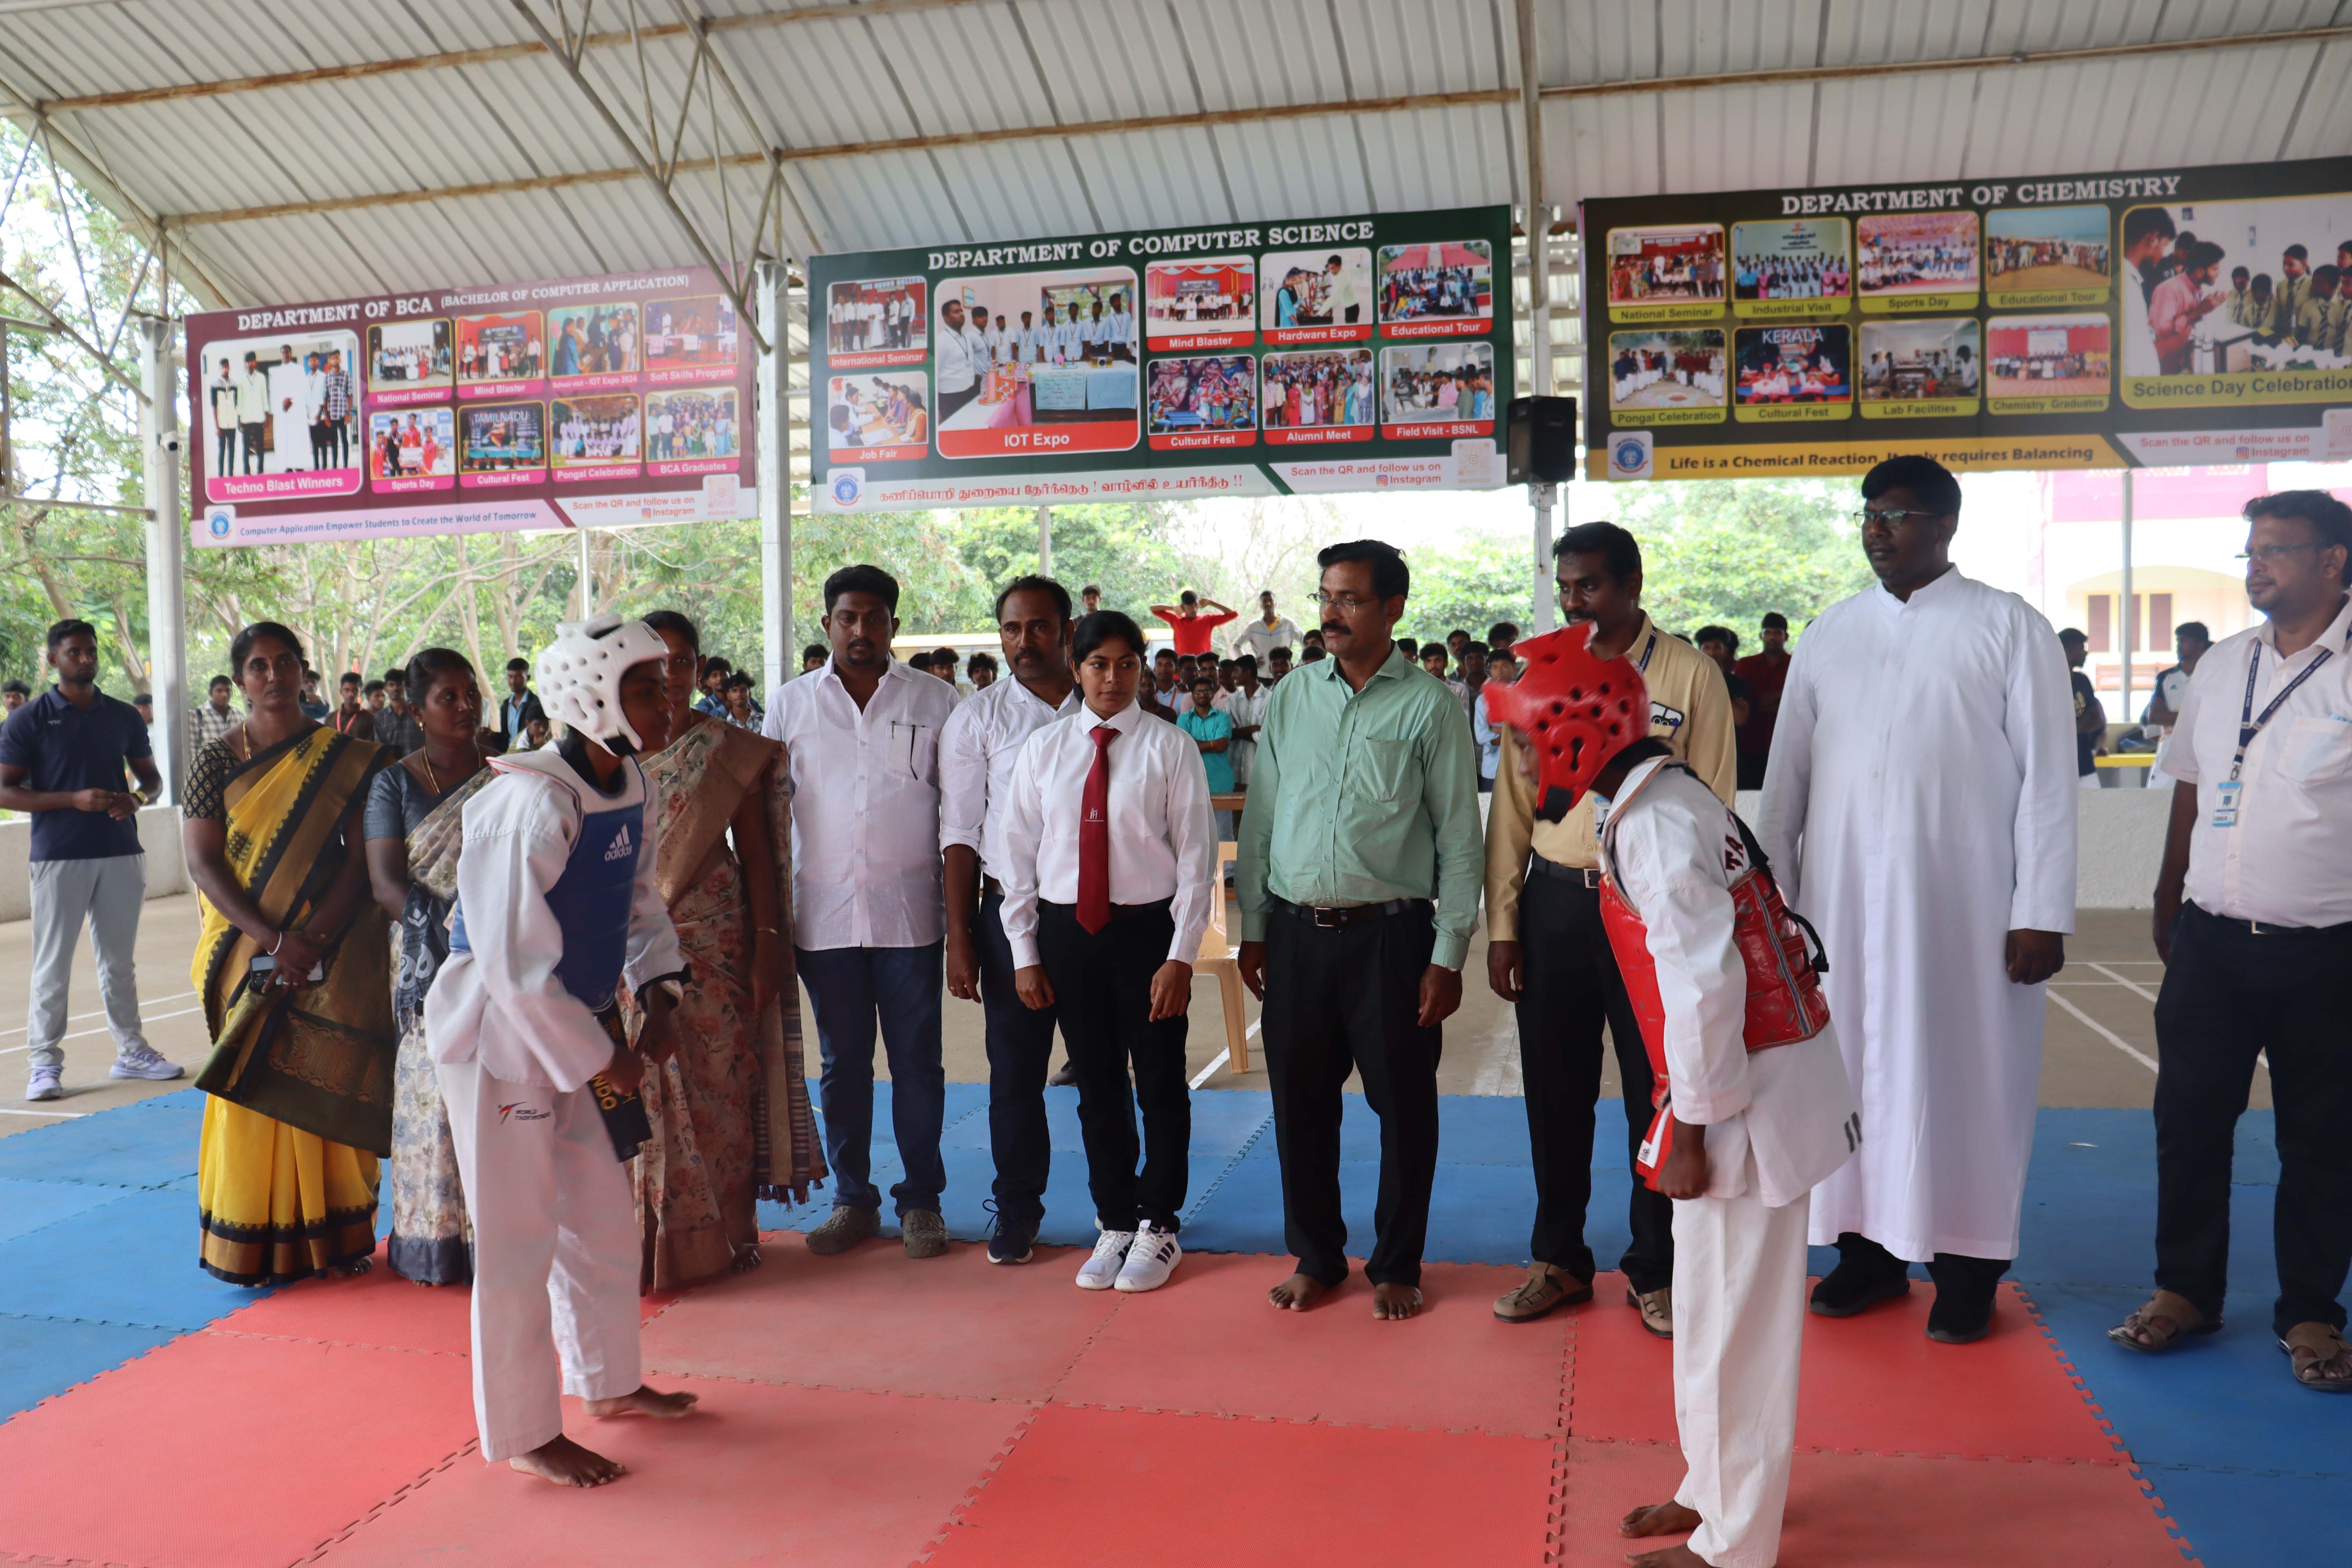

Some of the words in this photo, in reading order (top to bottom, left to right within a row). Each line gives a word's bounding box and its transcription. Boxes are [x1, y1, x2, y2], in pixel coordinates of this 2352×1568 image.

[1782, 186, 1964, 215] DEPARTMENT
[1972, 185, 2009, 205] OF
[2016, 176, 2181, 203] CHEMISTRY
[927, 242, 1083, 270] DEPARTMENT
[1090, 240, 1121, 258] OF
[1129, 229, 1261, 255] COMPUTER
[1269, 221, 1374, 245] SCIENCE
[238, 303, 360, 331] DEPARTMENT
[365, 301, 390, 318] OF
[395, 297, 433, 315] BCA
[441, 292, 508, 308] (BACHELOR
[512, 290, 528, 301] OF
[532, 283, 599, 299] COMPUTER
[603, 275, 689, 292] APPLICATION)
[1889, 298, 1925, 309] Sports
[1928, 296, 1949, 308] Day
[2000, 294, 2067, 305] Educational
[2071, 292, 2096, 302] Tour
[1621, 309, 1665, 319] National
[1669, 307, 1713, 318] Seminar
[1752, 303, 1804, 314] Industrial
[1808, 302, 1831, 313] Visit
[1278, 329, 1327, 341] Hardware
[1330, 328, 1356, 340] Expo
[1391, 324, 1453, 336] Educational
[1456, 323, 1480, 332] Tour
[1169, 338, 1194, 348] Mind
[1197, 336, 1232, 347] Blaster
[1762, 328, 1824, 344] KERALA
[831, 354, 885, 367] International
[887, 353, 923, 363] Seminar
[589, 377, 600, 386] IOT
[603, 377, 619, 386] Expo
[621, 375, 637, 384] 2024
[650, 372, 668, 381] Soft
[670, 371, 693, 380] Skills
[695, 369, 733, 381] Program
[474, 386, 494, 395] Mind
[496, 384, 526, 393] Blaster
[2134, 382, 2205, 397] Science
[2212, 380, 2246, 397] Day
[377, 392, 409, 403] National
[411, 390, 444, 401] Seminar
[1884, 405, 1904, 415] Lab
[1907, 403, 1957, 415] Facilities
[1994, 400, 2045, 412] Chemistry
[2051, 398, 2104, 409] Graduates
[474, 411, 528, 423] TAMILNADU
[1617, 413, 1655, 425] Pongal
[1658, 410, 1720, 422] Celebration
[1759, 408, 1802, 419] Cultural
[1805, 407, 1829, 417] Fest
[1287, 431, 1323, 442] Alumni
[1326, 430, 1351, 440] Meet
[1396, 426, 1419, 437] Field
[1423, 425, 1443, 436] Visit
[1452, 425, 1478, 434] BSNL
[1004, 434, 1029, 448] IOT
[1033, 433, 1070, 448] Expo
[1171, 436, 1210, 446] Cultural
[1213, 435, 1236, 445] Fest
[2141, 437, 2169, 447] Scan
[2172, 436, 2189, 446] the
[2193, 436, 2210, 446] QR
[2215, 435, 2235, 445] and
[2239, 434, 2274, 444] follow
[859, 450, 877, 460] Job
[880, 448, 897, 459] Fair
[1670, 458, 1699, 469] Life
[1703, 457, 1714, 468] is
[1731, 455, 1804, 467] Chemical
[1942, 450, 2008, 464] requires
[2013, 447, 2093, 461] Balancing
[2252, 447, 2309, 458] Instagram
[557, 470, 586, 481] Pongal
[588, 467, 637, 477] Celebration
[660, 465, 680, 474] BCA
[682, 462, 727, 472] Graduates
[1291, 466, 1316, 475] Scan
[1319, 466, 1335, 474] the
[1338, 465, 1353, 475] QR
[1356, 464, 1375, 473] and
[1379, 463, 1410, 472] follow
[224, 482, 263, 495] Techno
[266, 479, 294, 492] Blast
[297, 476, 343, 489] Winners
[392, 481, 417, 491] Sports
[419, 479, 435, 490] Day
[477, 475, 510, 485] Cultural
[511, 474, 530, 483] Fest
[1390, 474, 1441, 486] Instagram
[879, 488, 955, 502] கணிப்பொறி
[958, 487, 1020, 501] துறையை
[1024, 483, 1089, 496] தேர்ந்தெடு
[1101, 478, 1158, 493] வாழ்வில்
[1162, 475, 1229, 489] உயர்ந்திடு
[610, 499, 624, 508] QR
[626, 499, 641, 507] and
[643, 497, 669, 506] follow
[652, 507, 695, 518] Instagram
[240, 526, 277, 537] Computer
[279, 523, 324, 534] Application
[326, 521, 363, 532] Empower
[364, 518, 399, 528] Students
[412, 516, 437, 525] Create
[440, 515, 453, 524] the
[455, 513, 480, 523] World
[482, 512, 491, 521] of
[493, 511, 536, 521] Tomorrow
[605, 844, 632, 862] adidas
